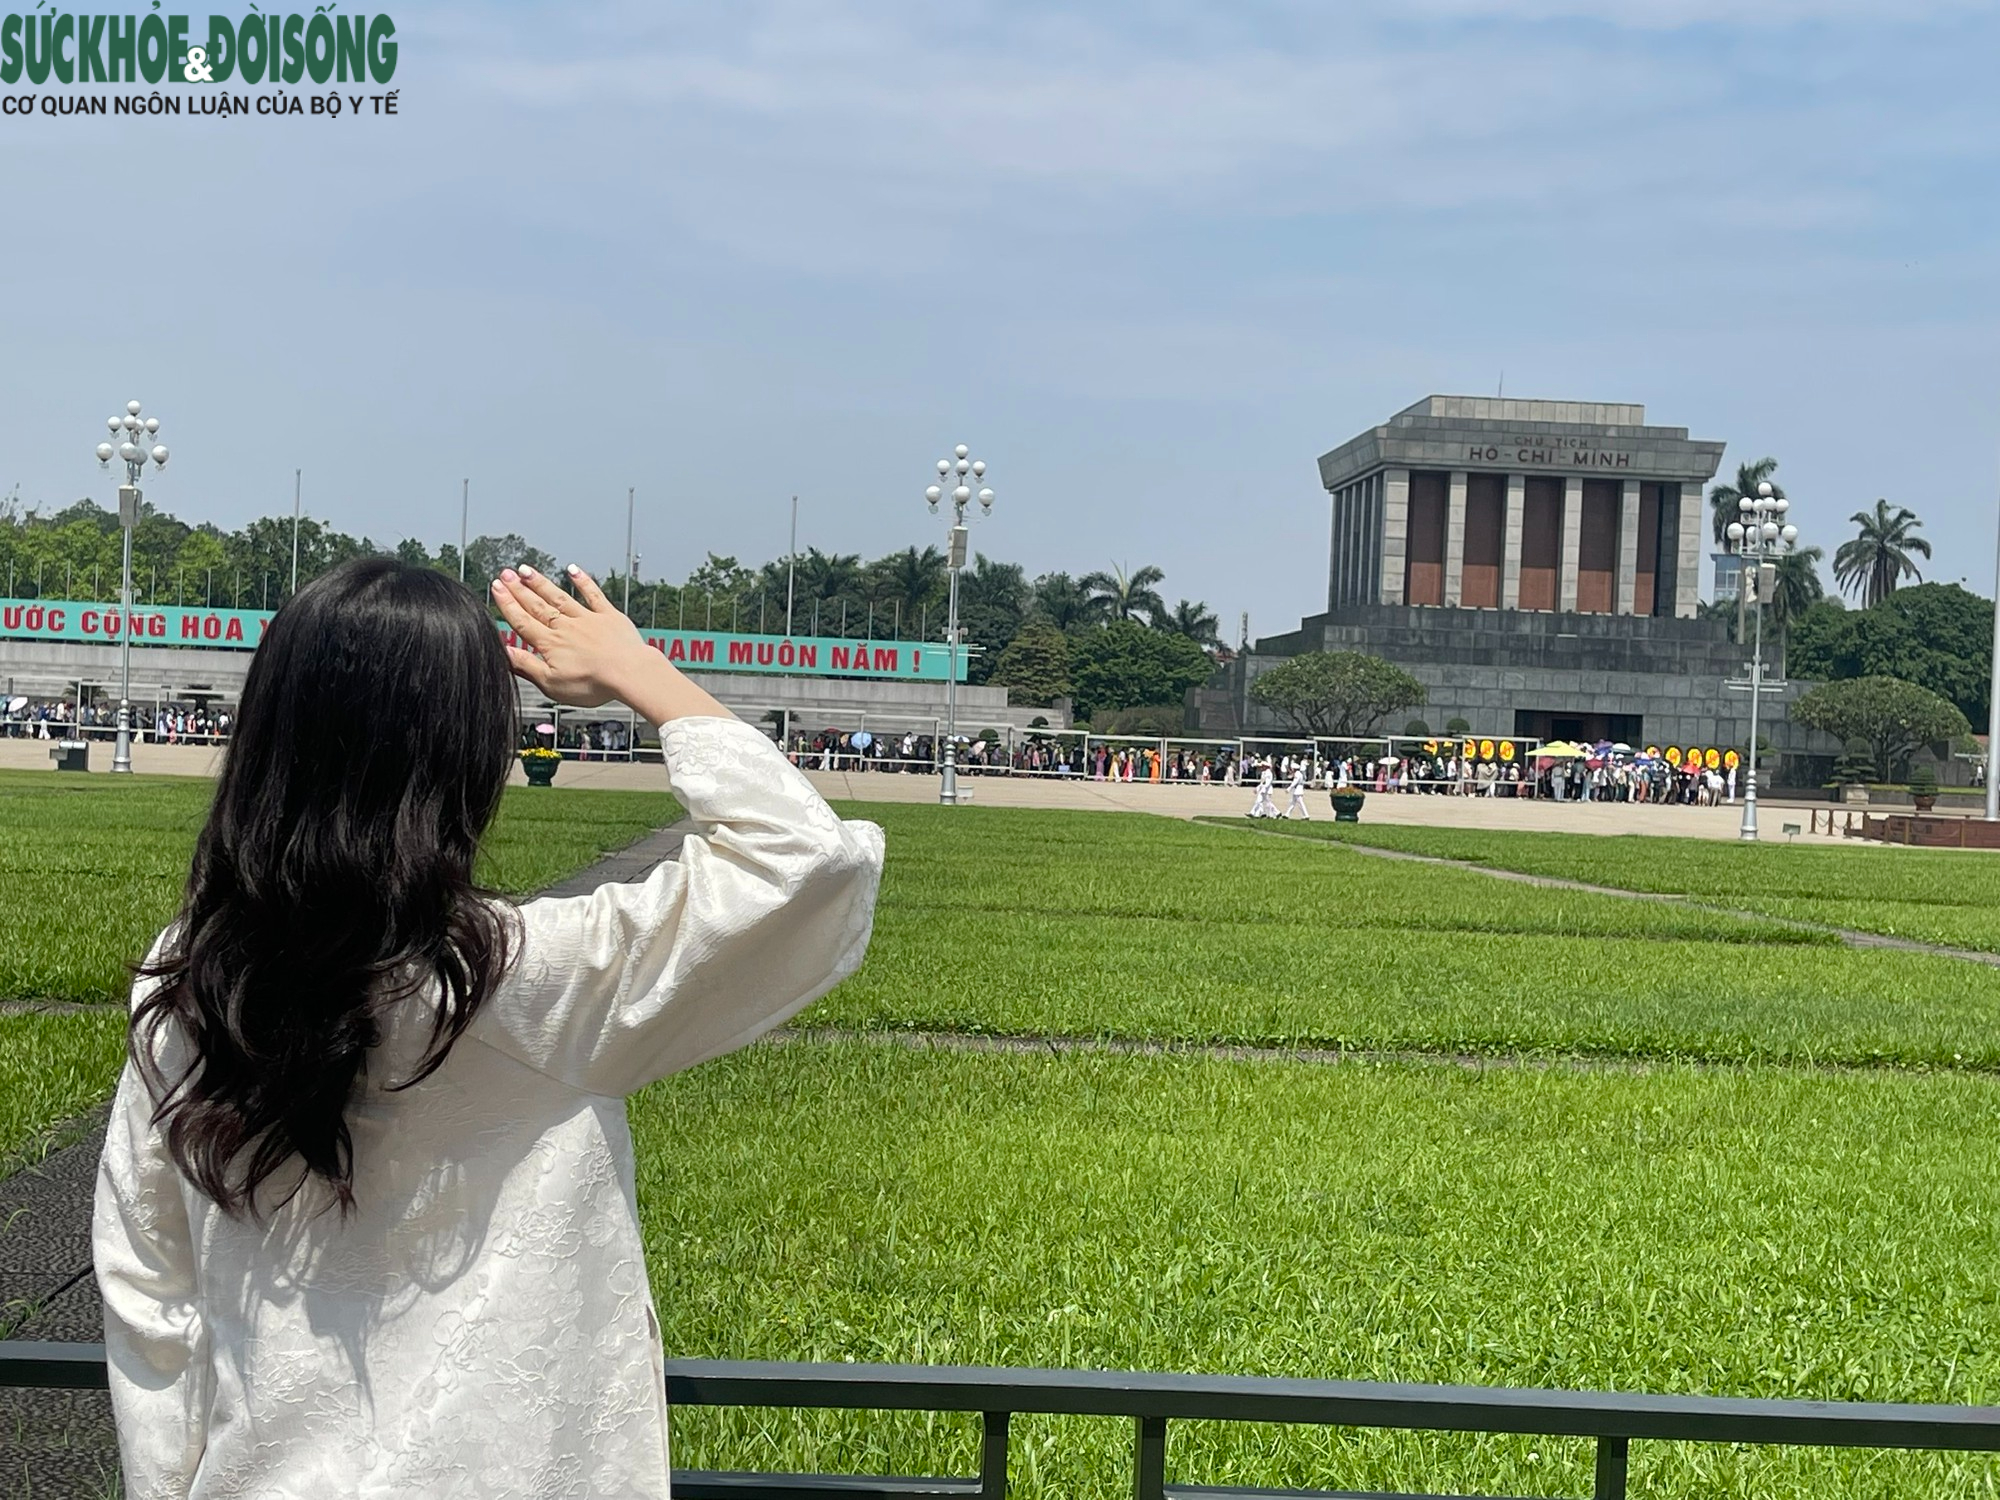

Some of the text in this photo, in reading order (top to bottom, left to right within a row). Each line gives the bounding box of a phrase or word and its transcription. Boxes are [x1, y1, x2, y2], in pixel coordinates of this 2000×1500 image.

[81, 607, 166, 640] CỘNG
[729, 639, 817, 668] MUÔN
[831, 642, 898, 672] NĂM
[912, 650, 920, 673] !
